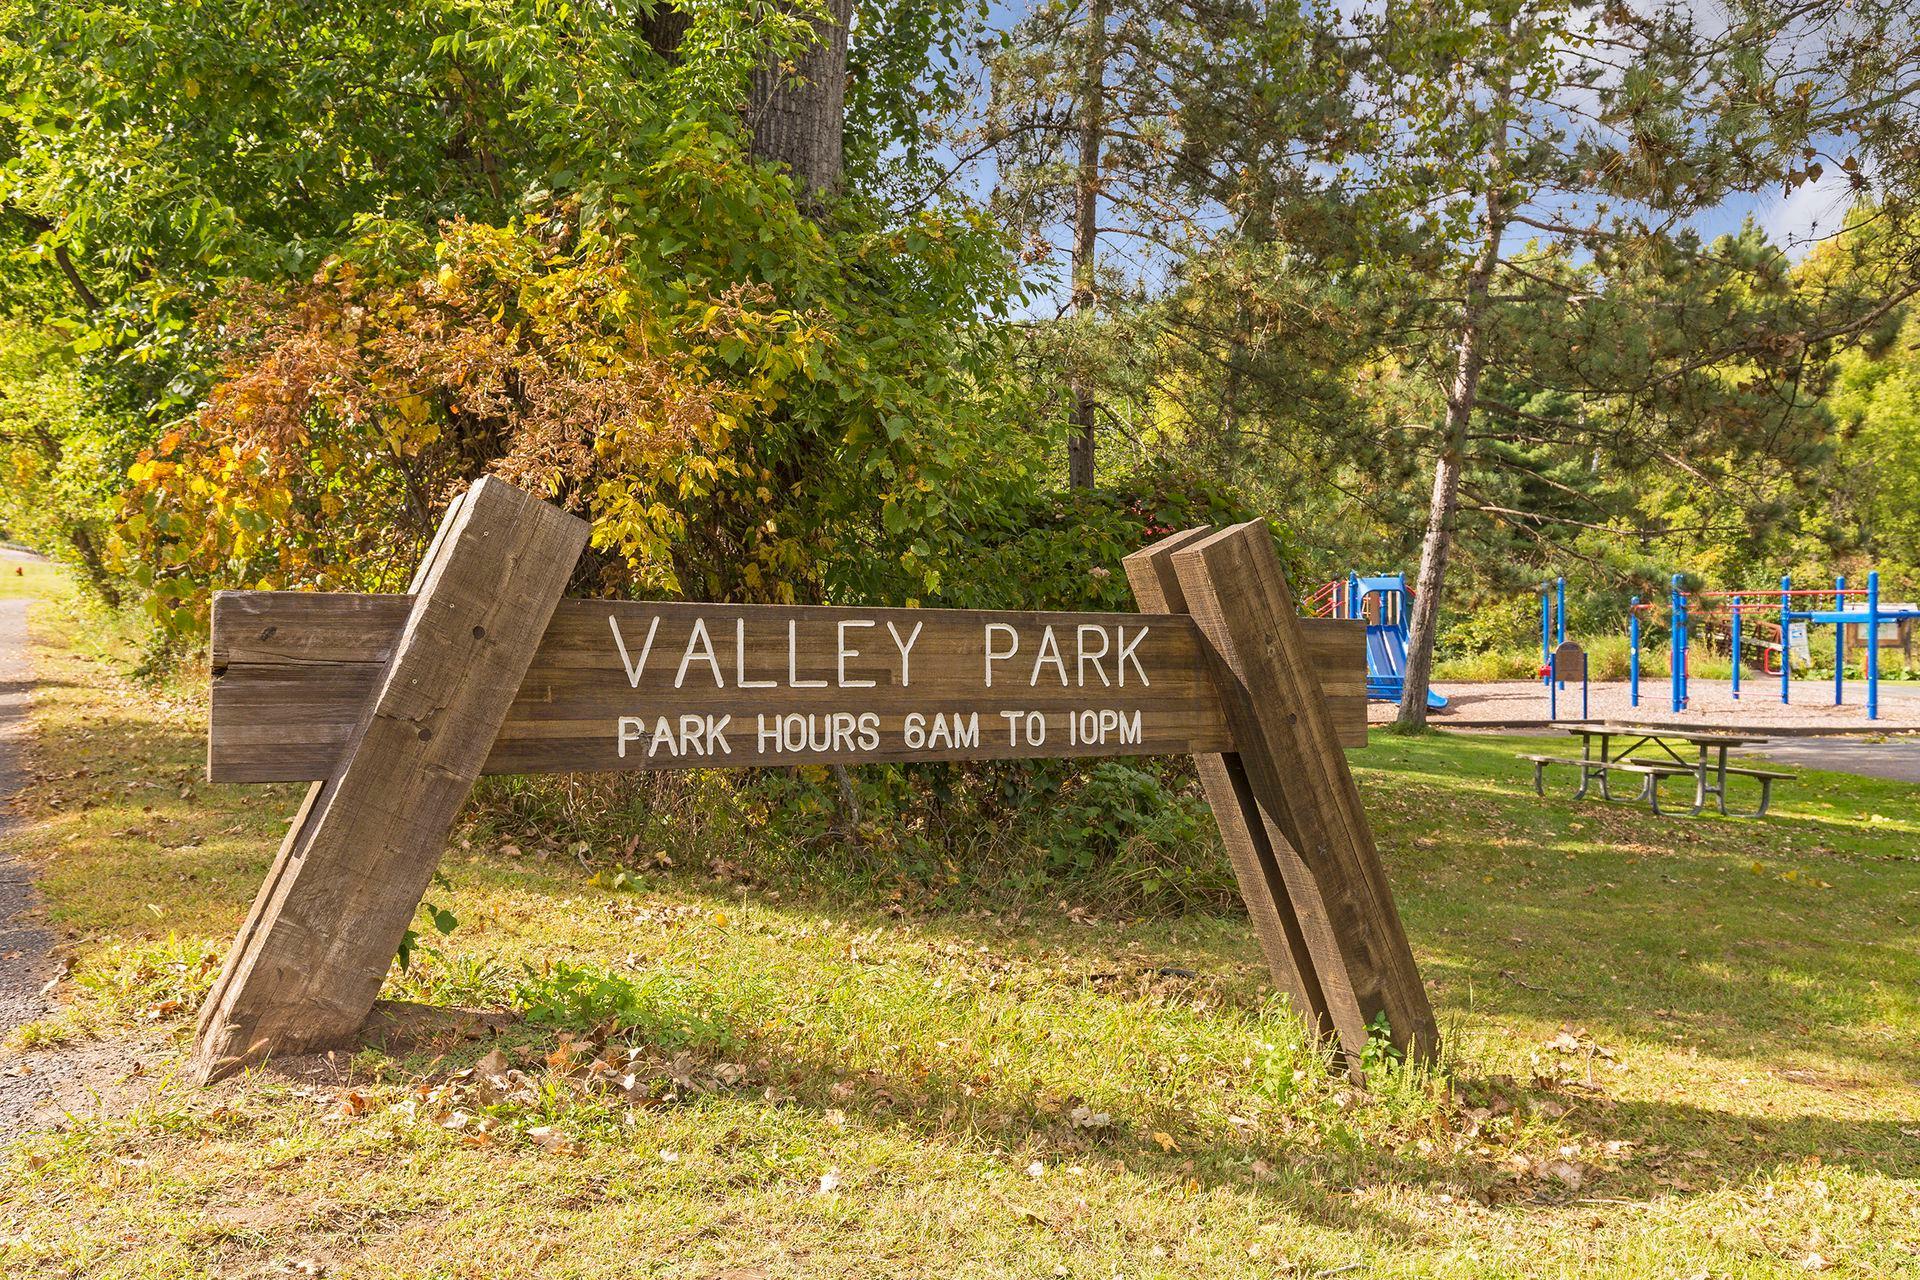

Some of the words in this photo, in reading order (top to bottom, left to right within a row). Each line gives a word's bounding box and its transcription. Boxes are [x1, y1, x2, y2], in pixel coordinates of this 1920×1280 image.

[609, 615, 924, 689] VALLEY
[984, 622, 1150, 688] PARK
[617, 713, 732, 758] PARK
[757, 711, 880, 755] HOURS
[904, 710, 980, 749] 6AM
[999, 709, 1046, 747] TO
[1069, 709, 1143, 745] 10PM
